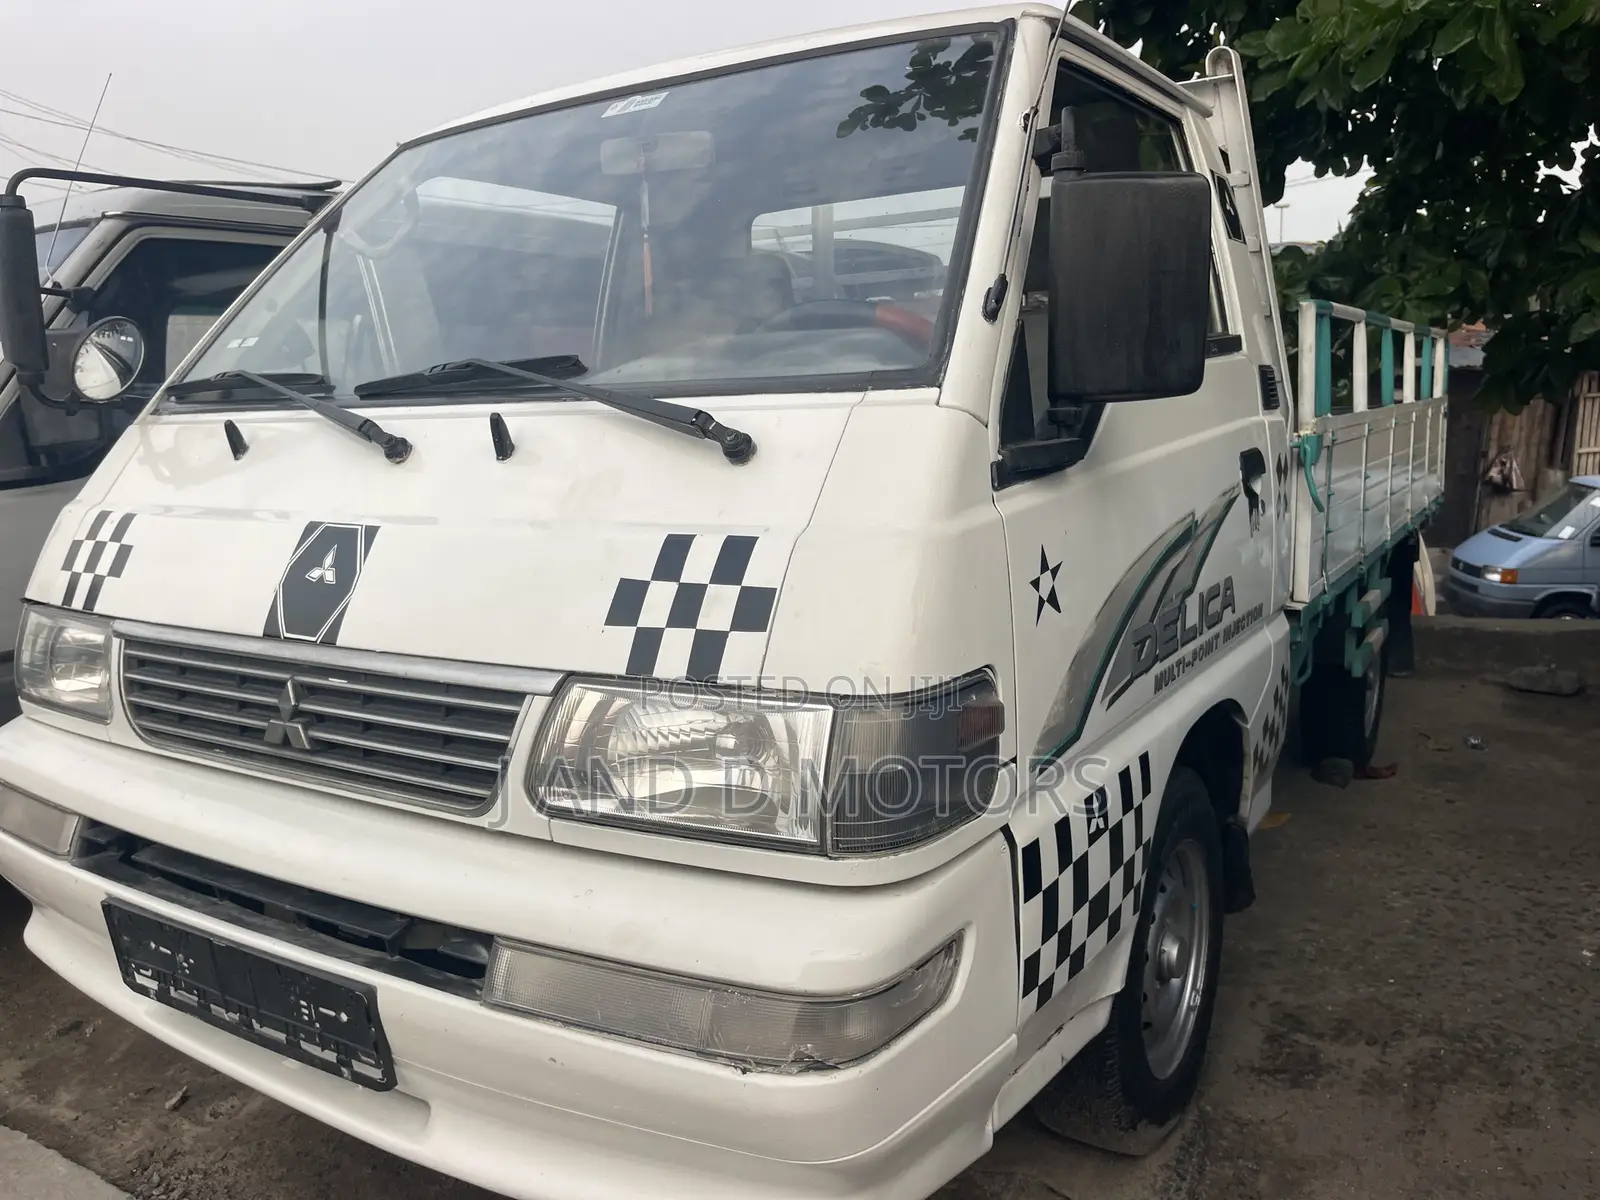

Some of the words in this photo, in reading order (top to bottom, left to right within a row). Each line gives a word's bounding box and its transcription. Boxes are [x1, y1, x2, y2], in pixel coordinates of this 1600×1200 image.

[1131, 576, 1235, 680] DELICA
[1154, 633, 1219, 694] MULTI-POINT
[1223, 602, 1264, 645] INJECTION
